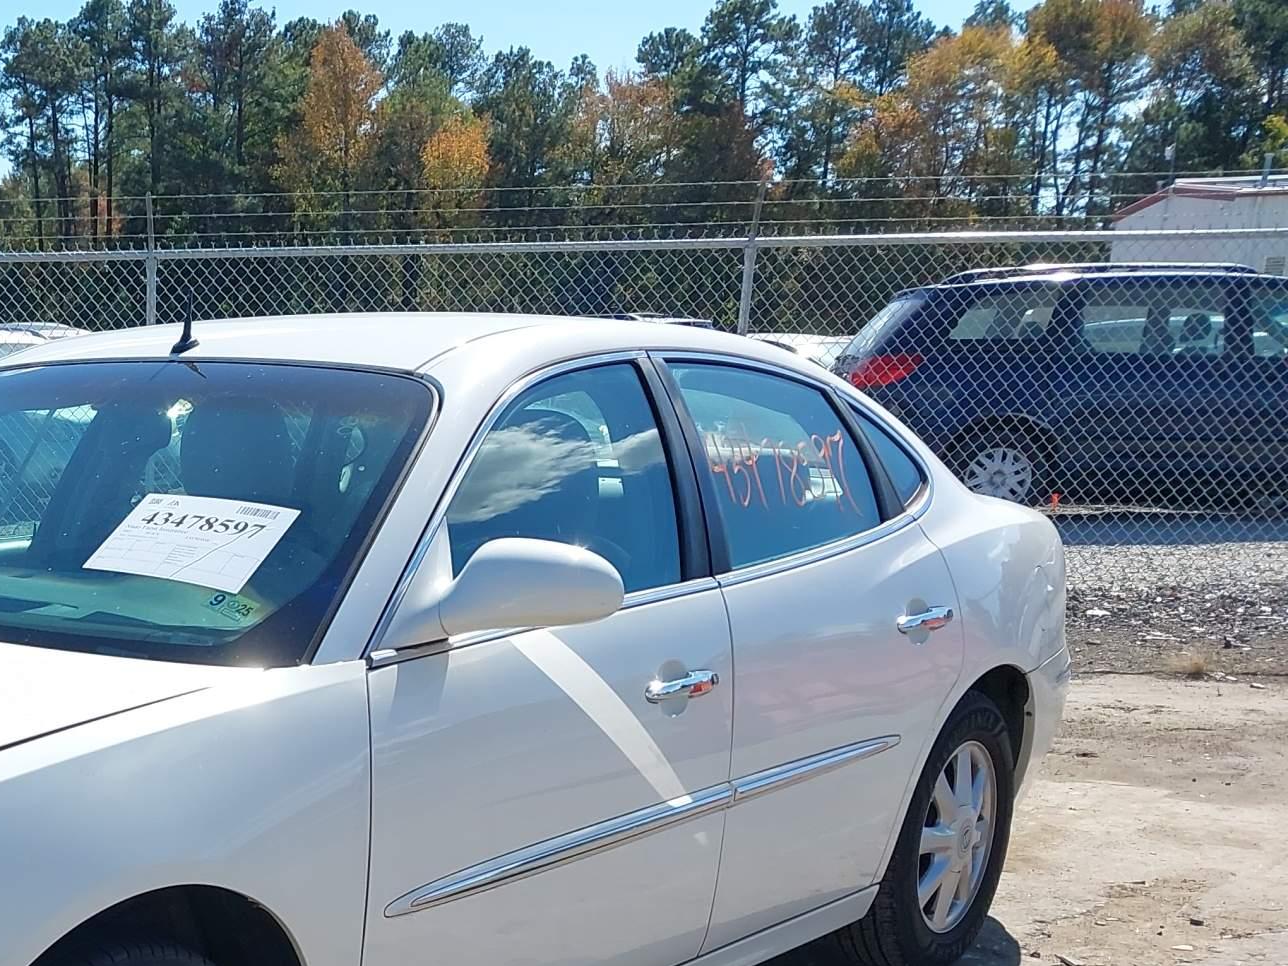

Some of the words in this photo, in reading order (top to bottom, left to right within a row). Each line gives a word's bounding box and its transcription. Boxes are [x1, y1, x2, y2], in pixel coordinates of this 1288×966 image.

[140, 510, 266, 540] 43478597
[209, 593, 227, 607] 9
[235, 604, 255, 617] 25
